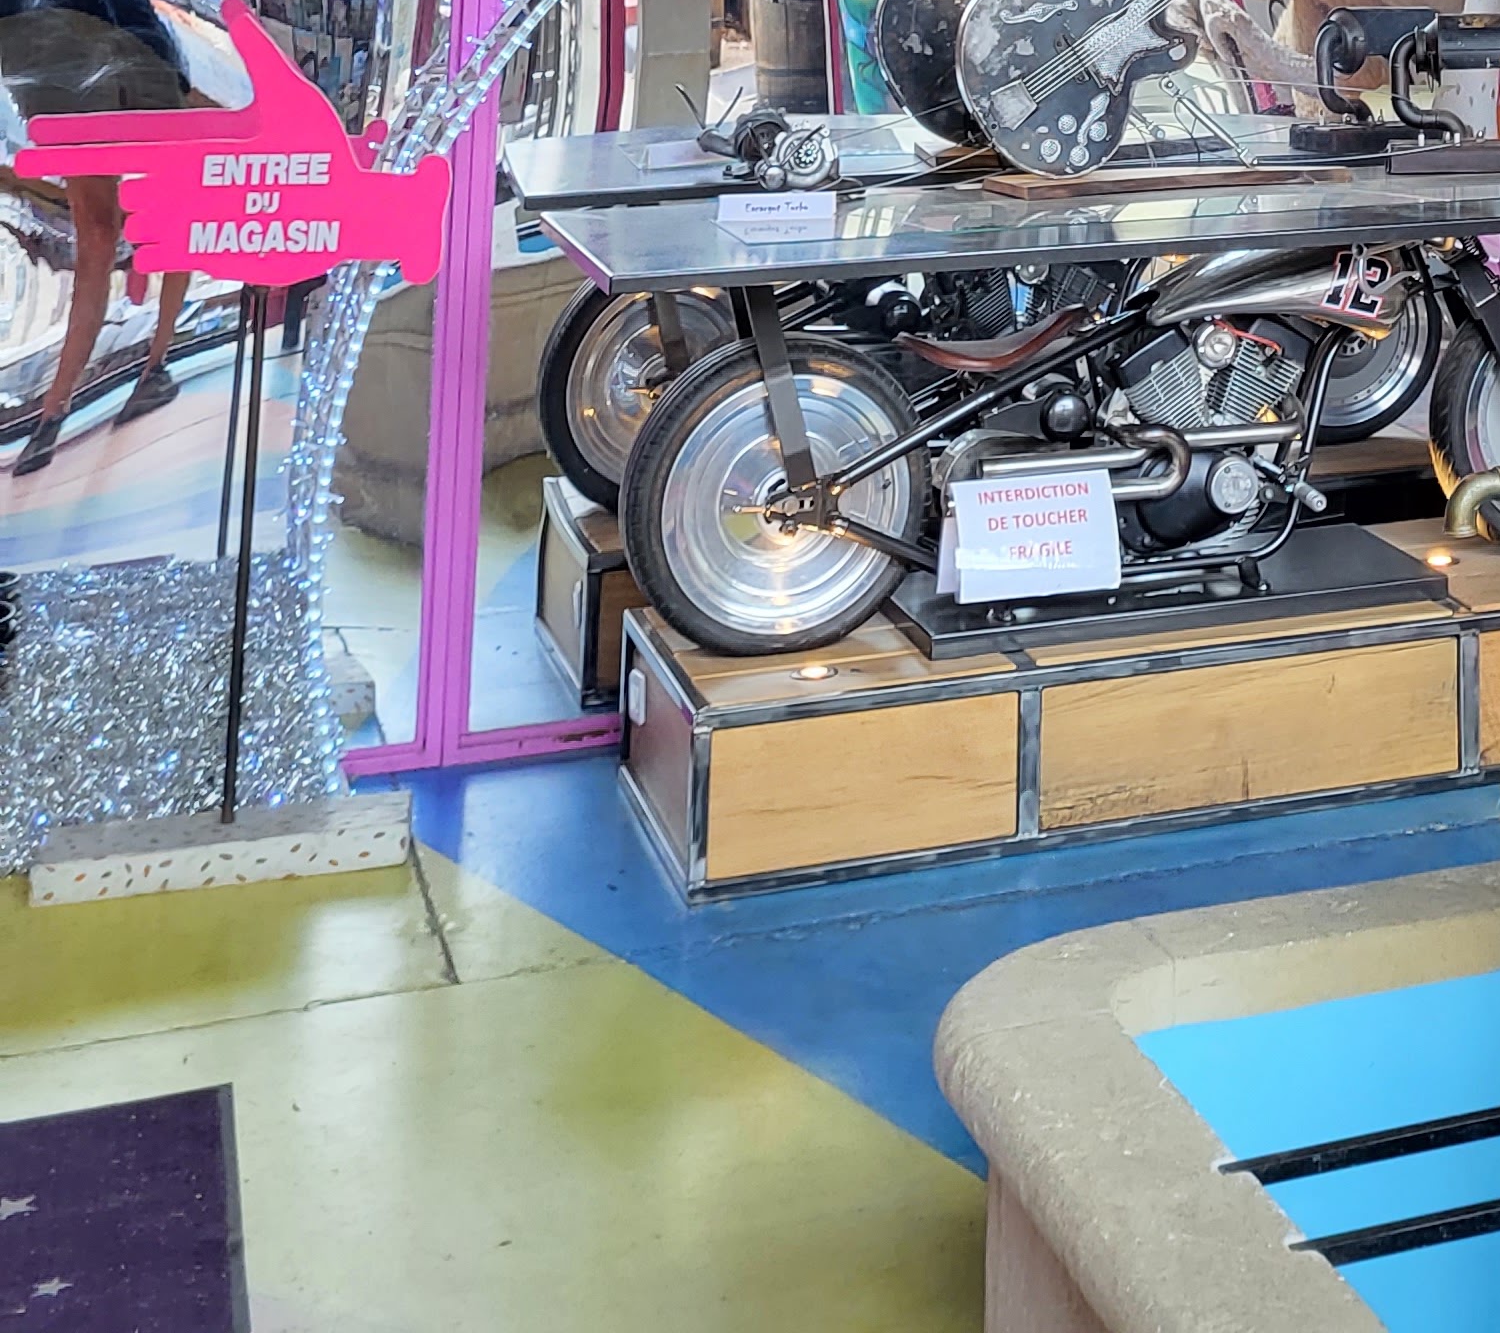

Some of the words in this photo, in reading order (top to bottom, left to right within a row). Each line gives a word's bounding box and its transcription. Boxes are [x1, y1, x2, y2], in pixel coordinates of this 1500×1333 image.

[201, 153, 332, 187] ENTREE
[244, 191, 281, 215] DU
[188, 219, 341, 255] MAGASIN
[977, 482, 1089, 505] INTERDICTION
[987, 516, 1009, 532] DE
[1012, 509, 1088, 528] TOUCHER
